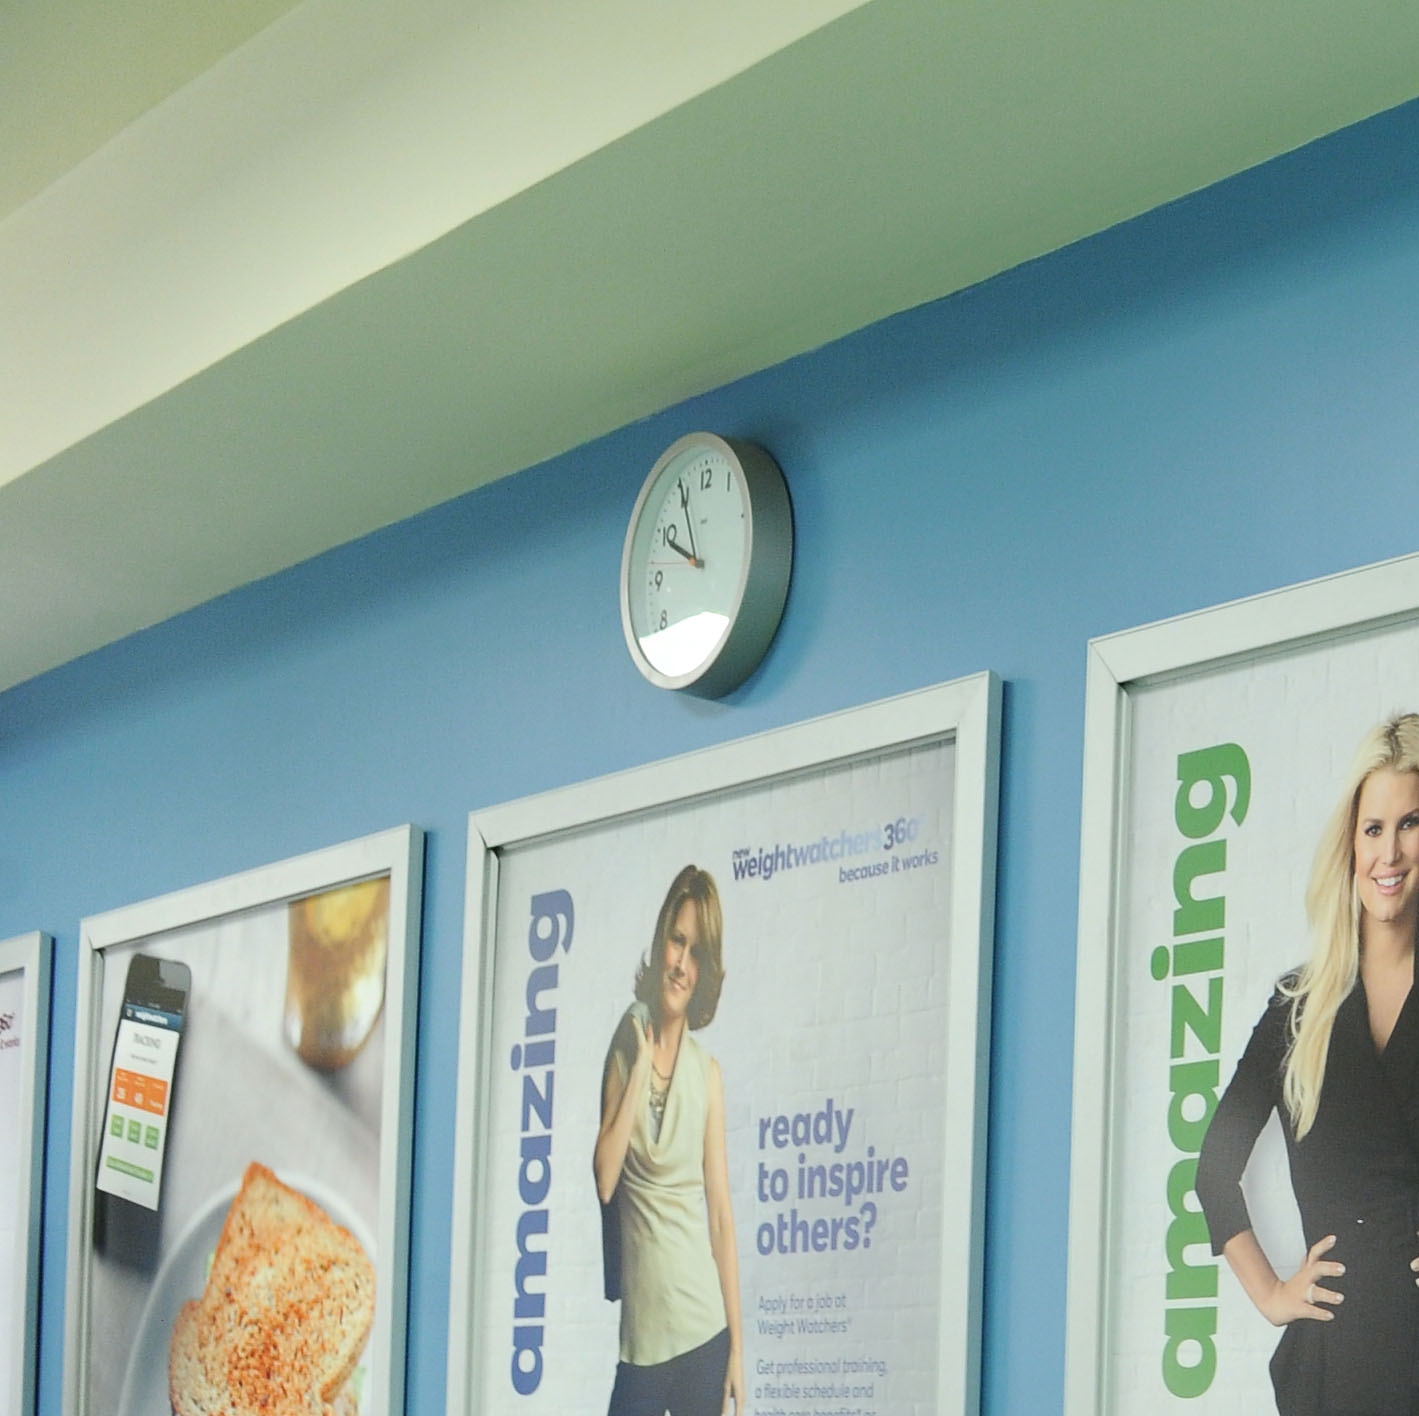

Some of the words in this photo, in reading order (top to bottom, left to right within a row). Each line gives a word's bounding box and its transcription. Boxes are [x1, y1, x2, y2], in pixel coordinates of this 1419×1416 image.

[701, 469, 712, 490] 12
[839, 861, 889, 883] because
[891, 856, 901, 873] it
[902, 849, 938, 870] works
[1150, 742, 1252, 1399] amazing
[510, 889, 574, 1396] amazing
[758, 1098, 855, 1153] ready
[758, 1162, 789, 1203] to
[798, 1146, 909, 1206] inspire
[757, 1202, 877, 1256] others?
